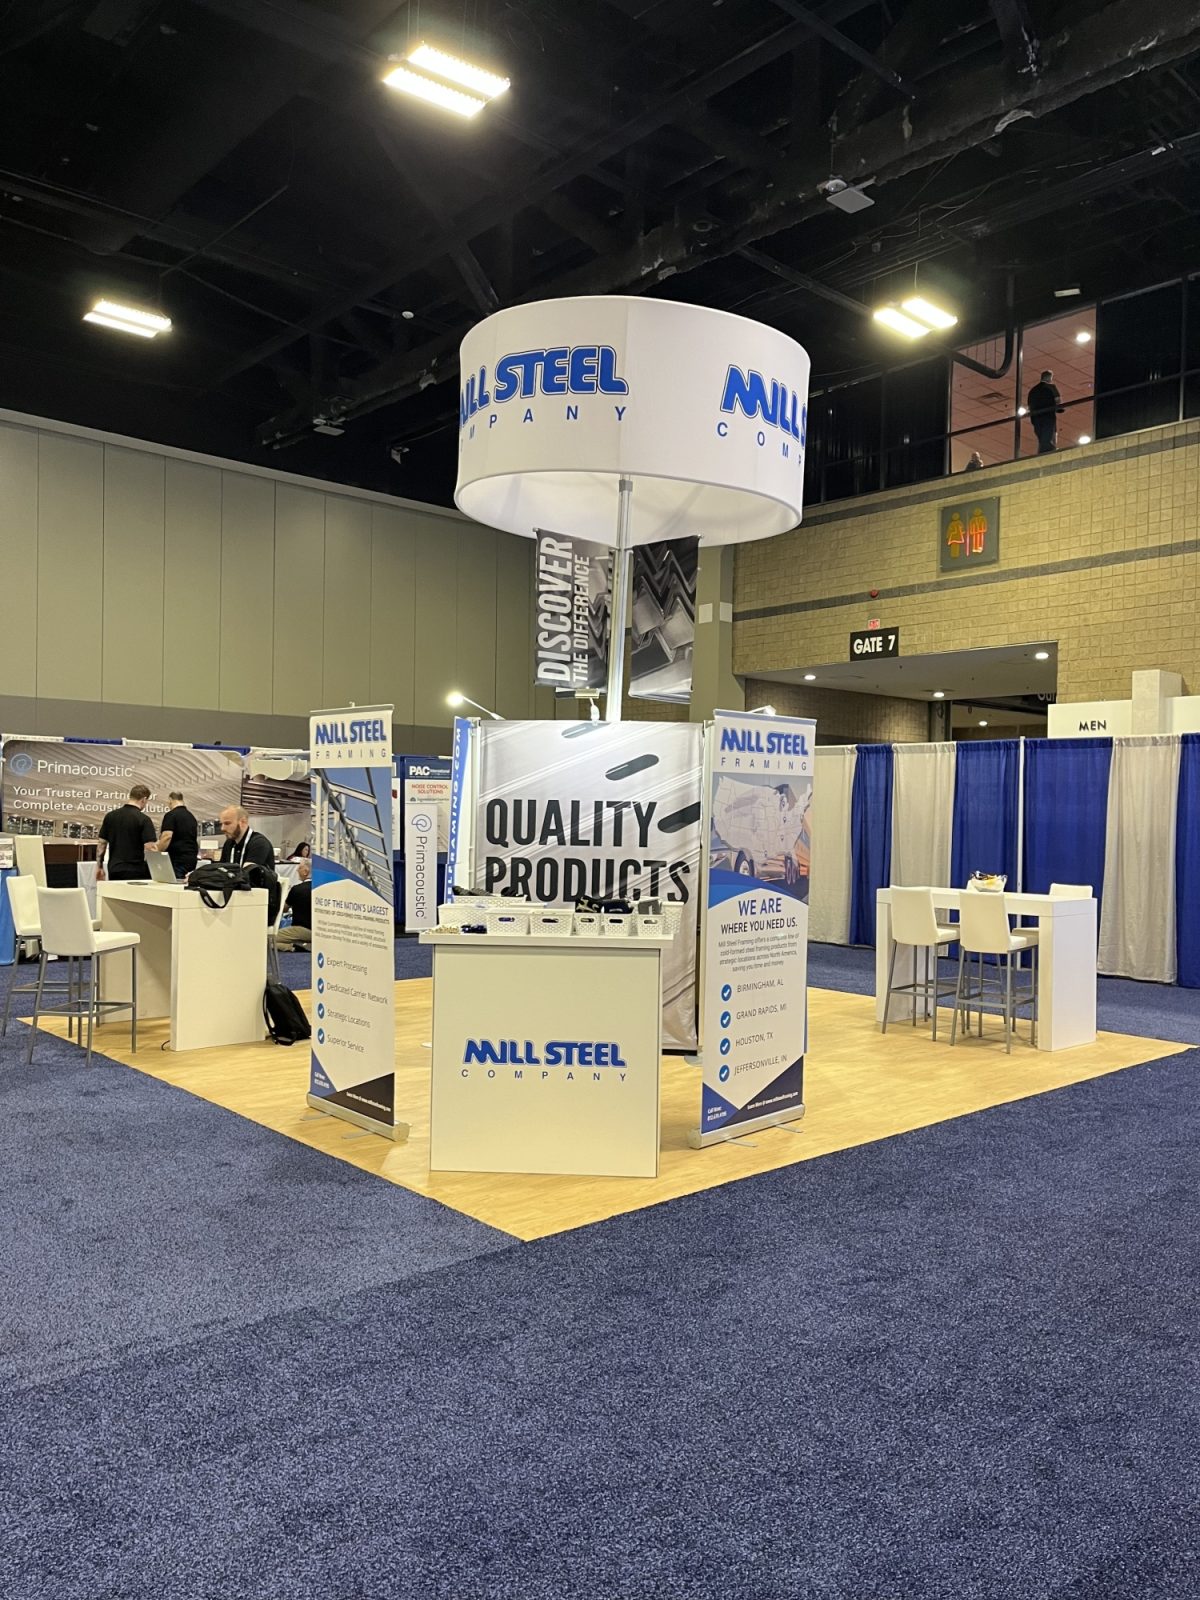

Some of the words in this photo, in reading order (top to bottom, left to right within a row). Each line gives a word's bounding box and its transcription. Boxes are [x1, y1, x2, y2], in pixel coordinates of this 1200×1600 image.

[494, 345, 629, 403] STEEL
[720, 364, 800, 443] MILL
[537, 536, 573, 682] DISCOVER
[573, 554, 590, 650] DIFFERENCE
[853, 636, 883, 654] GATE
[888, 634, 896, 651] 7
[573, 653, 588, 682] THE
[315, 722, 348, 745] MILL
[350, 719, 387, 743] STEEL
[1079, 719, 1107, 731] MEN
[720, 727, 765, 754] MILL
[766, 732, 809, 757] STEEL
[316, 748, 387, 760] FRAMING
[37, 759, 133, 777] Primacoustic
[409, 765, 430, 776] PAC
[720, 757, 807, 771] FRAMING
[13, 786, 41, 796] Your
[45, 787, 91, 798] Trusted
[95, 789, 131, 800] Partne
[13, 800, 73, 812] Complete
[486, 798, 658, 848] QUALITY
[415, 836, 428, 918] Primacoustic
[485, 856, 691, 905] PRODUCTS
[332, 899, 343, 909] THE
[367, 905, 389, 916] LARGEST
[738, 899, 757, 917] WE
[760, 897, 782, 914] ARE
[720, 921, 748, 935] WHERE
[750, 919, 765, 932] YOU
[766, 917, 785, 930] NEED
[326, 957, 343, 969] Expert
[343, 960, 368, 976] Processing
[326, 982, 350, 995] Dedicated
[350, 988, 367, 999] Carrier
[367, 992, 389, 1005] Network
[736, 980, 776, 993] BIRMINGHAM,
[327, 1009, 347, 1023] Strategic
[347, 1015, 371, 1029] Locations
[736, 1008, 757, 1020] GRAND
[327, 1034, 347, 1047] Superior
[347, 1040, 365, 1053] Service
[735, 1033, 766, 1047] HOUSTON,
[766, 1031, 774, 1040] TX
[463, 1038, 541, 1065] MILL
[544, 1039, 627, 1068] STEEL
[780, 1054, 788, 1062] IN
[461, 1069, 626, 1082] COMPANY
